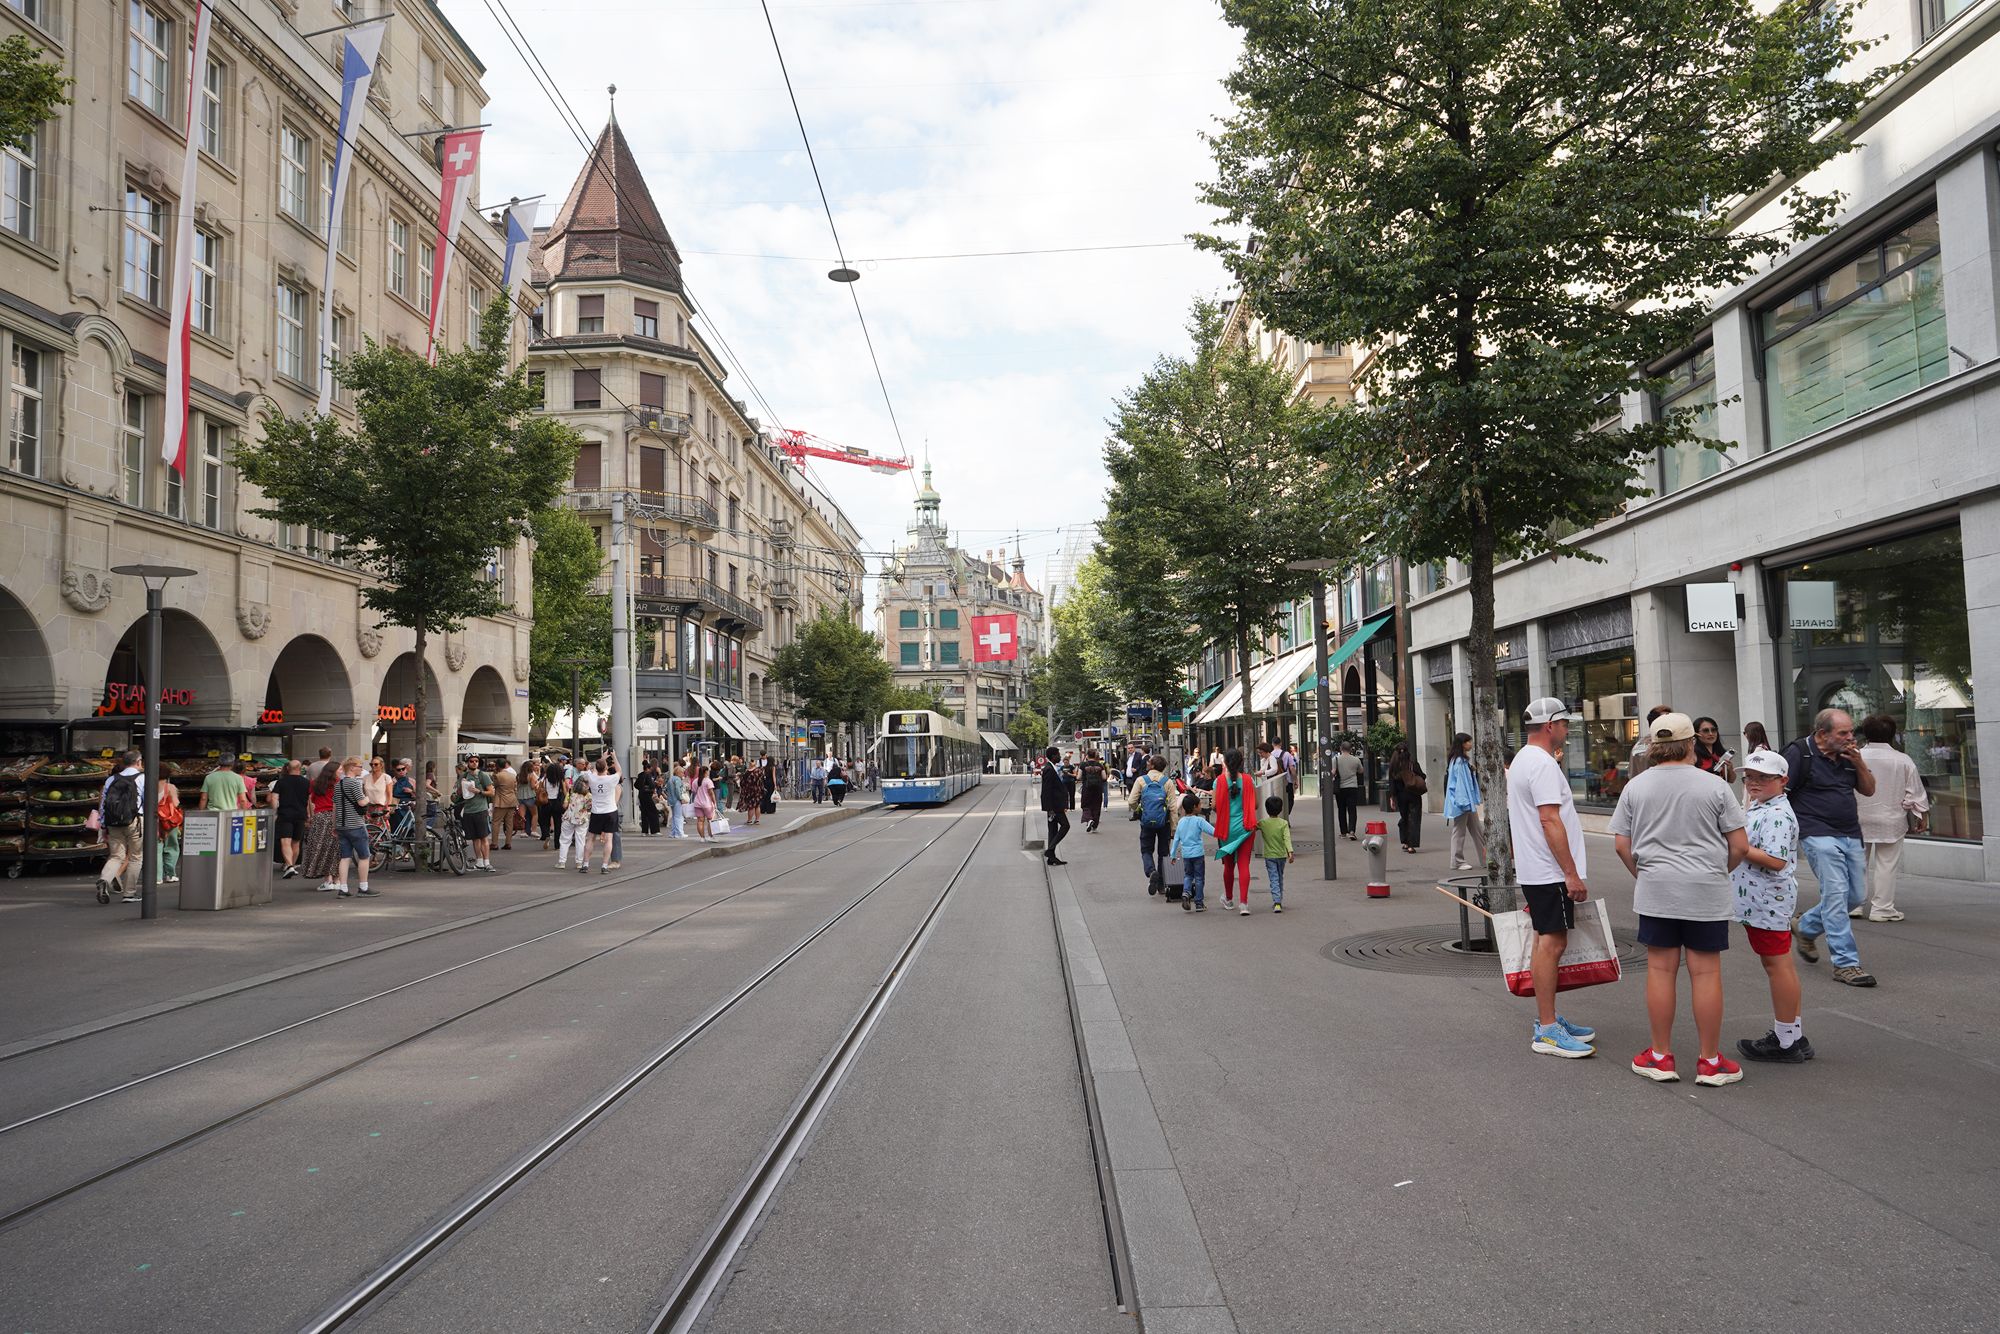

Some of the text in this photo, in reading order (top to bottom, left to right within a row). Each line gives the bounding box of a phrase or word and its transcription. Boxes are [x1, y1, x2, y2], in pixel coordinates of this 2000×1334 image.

[634, 603, 680, 613] AR CAFE
[1691, 620, 1736, 630] CHANEL
[109, 682, 198, 705] ST.ANAHOF
[904, 715, 914, 723] 13
